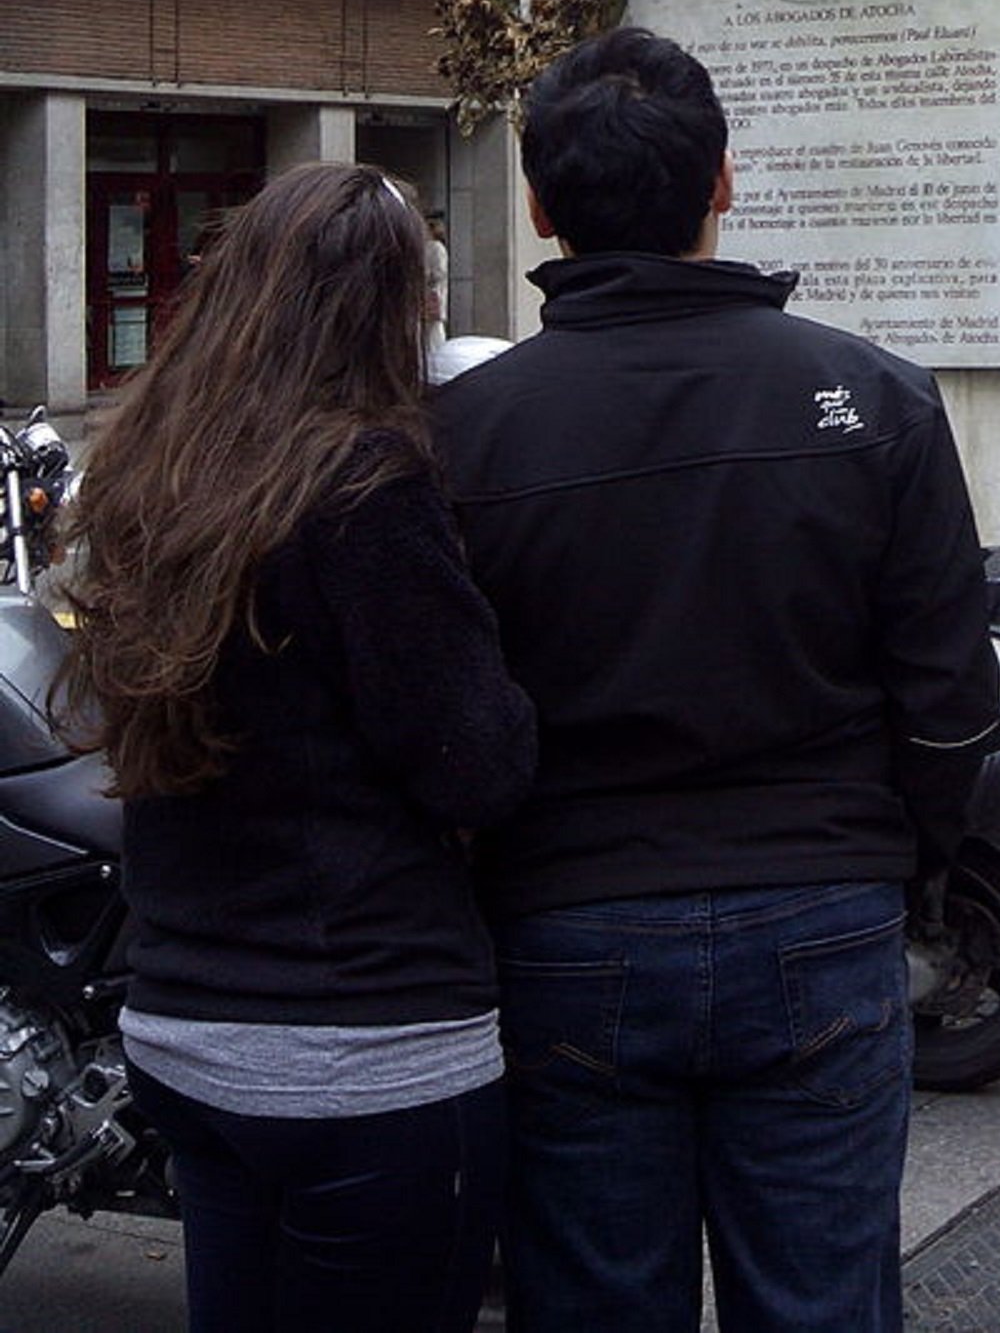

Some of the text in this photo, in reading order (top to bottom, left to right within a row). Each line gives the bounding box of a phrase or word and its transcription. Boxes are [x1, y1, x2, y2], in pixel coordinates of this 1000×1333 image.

[724, 3, 916, 27] A LOS ABOGADOS DE ATOCHA
[719, 40, 733, 51] de
[735, 62, 748, 73] de
[780, 62, 793, 72] en
[812, 57, 857, 71] despacho
[861, 55, 874, 66] de
[877, 53, 927, 68] Abogados
[759, 77, 772, 87] en
[775, 74, 784, 86] el
[844, 70, 857, 82] de
[860, 69, 881, 81] esta
[925, 65, 951, 78] calle
[953, 63, 998, 77] Atocha,
[798, 85, 848, 101] abogados
[953, 77, 997, 93] dejando
[771, 103, 821, 117] abogados
[857, 97, 887, 109] Todos
[979, 92, 997, 104] del
[740, 145, 793, 159] reproduce
[796, 145, 806, 156] el
[867, 140, 893, 154] Juan
[895, 137, 943, 153] Genovés
[945, 136, 998, 149] conocido
[809, 158, 821, 169] de
[905, 155, 921, 166] de
[743, 192, 760, 203] por
[764, 189, 774, 201] el
[778, 187, 849, 202] Ayuntamiento
[867, 184, 906, 197] Madrid
[936, 183, 950, 196] de
[983, 181, 998, 194] de
[942, 197, 998, 212] despacho
[748, 216, 797, 230] homenaje
[901, 215, 920, 227] por
[936, 211, 980, 224] libertad
[854, 258, 871, 271] del
[891, 259, 954, 270] aniversario
[957, 256, 971, 269] de
[824, 274, 849, 286] esta
[854, 272, 886, 287] placa
[891, 272, 965, 287] explicativa,
[969, 274, 998, 286] para
[790, 290, 804, 302] de
[806, 287, 847, 301] Madrid
[849, 291, 857, 304] y
[860, 287, 875, 300] de
[877, 289, 917, 301] quienes
[920, 290, 940, 299] nos
[860, 316, 998, 333] Ayuntamiento de Madrid
[884, 332, 939, 345] Abogados
[941, 331, 955, 344] de
[959, 330, 998, 344] Atocha
